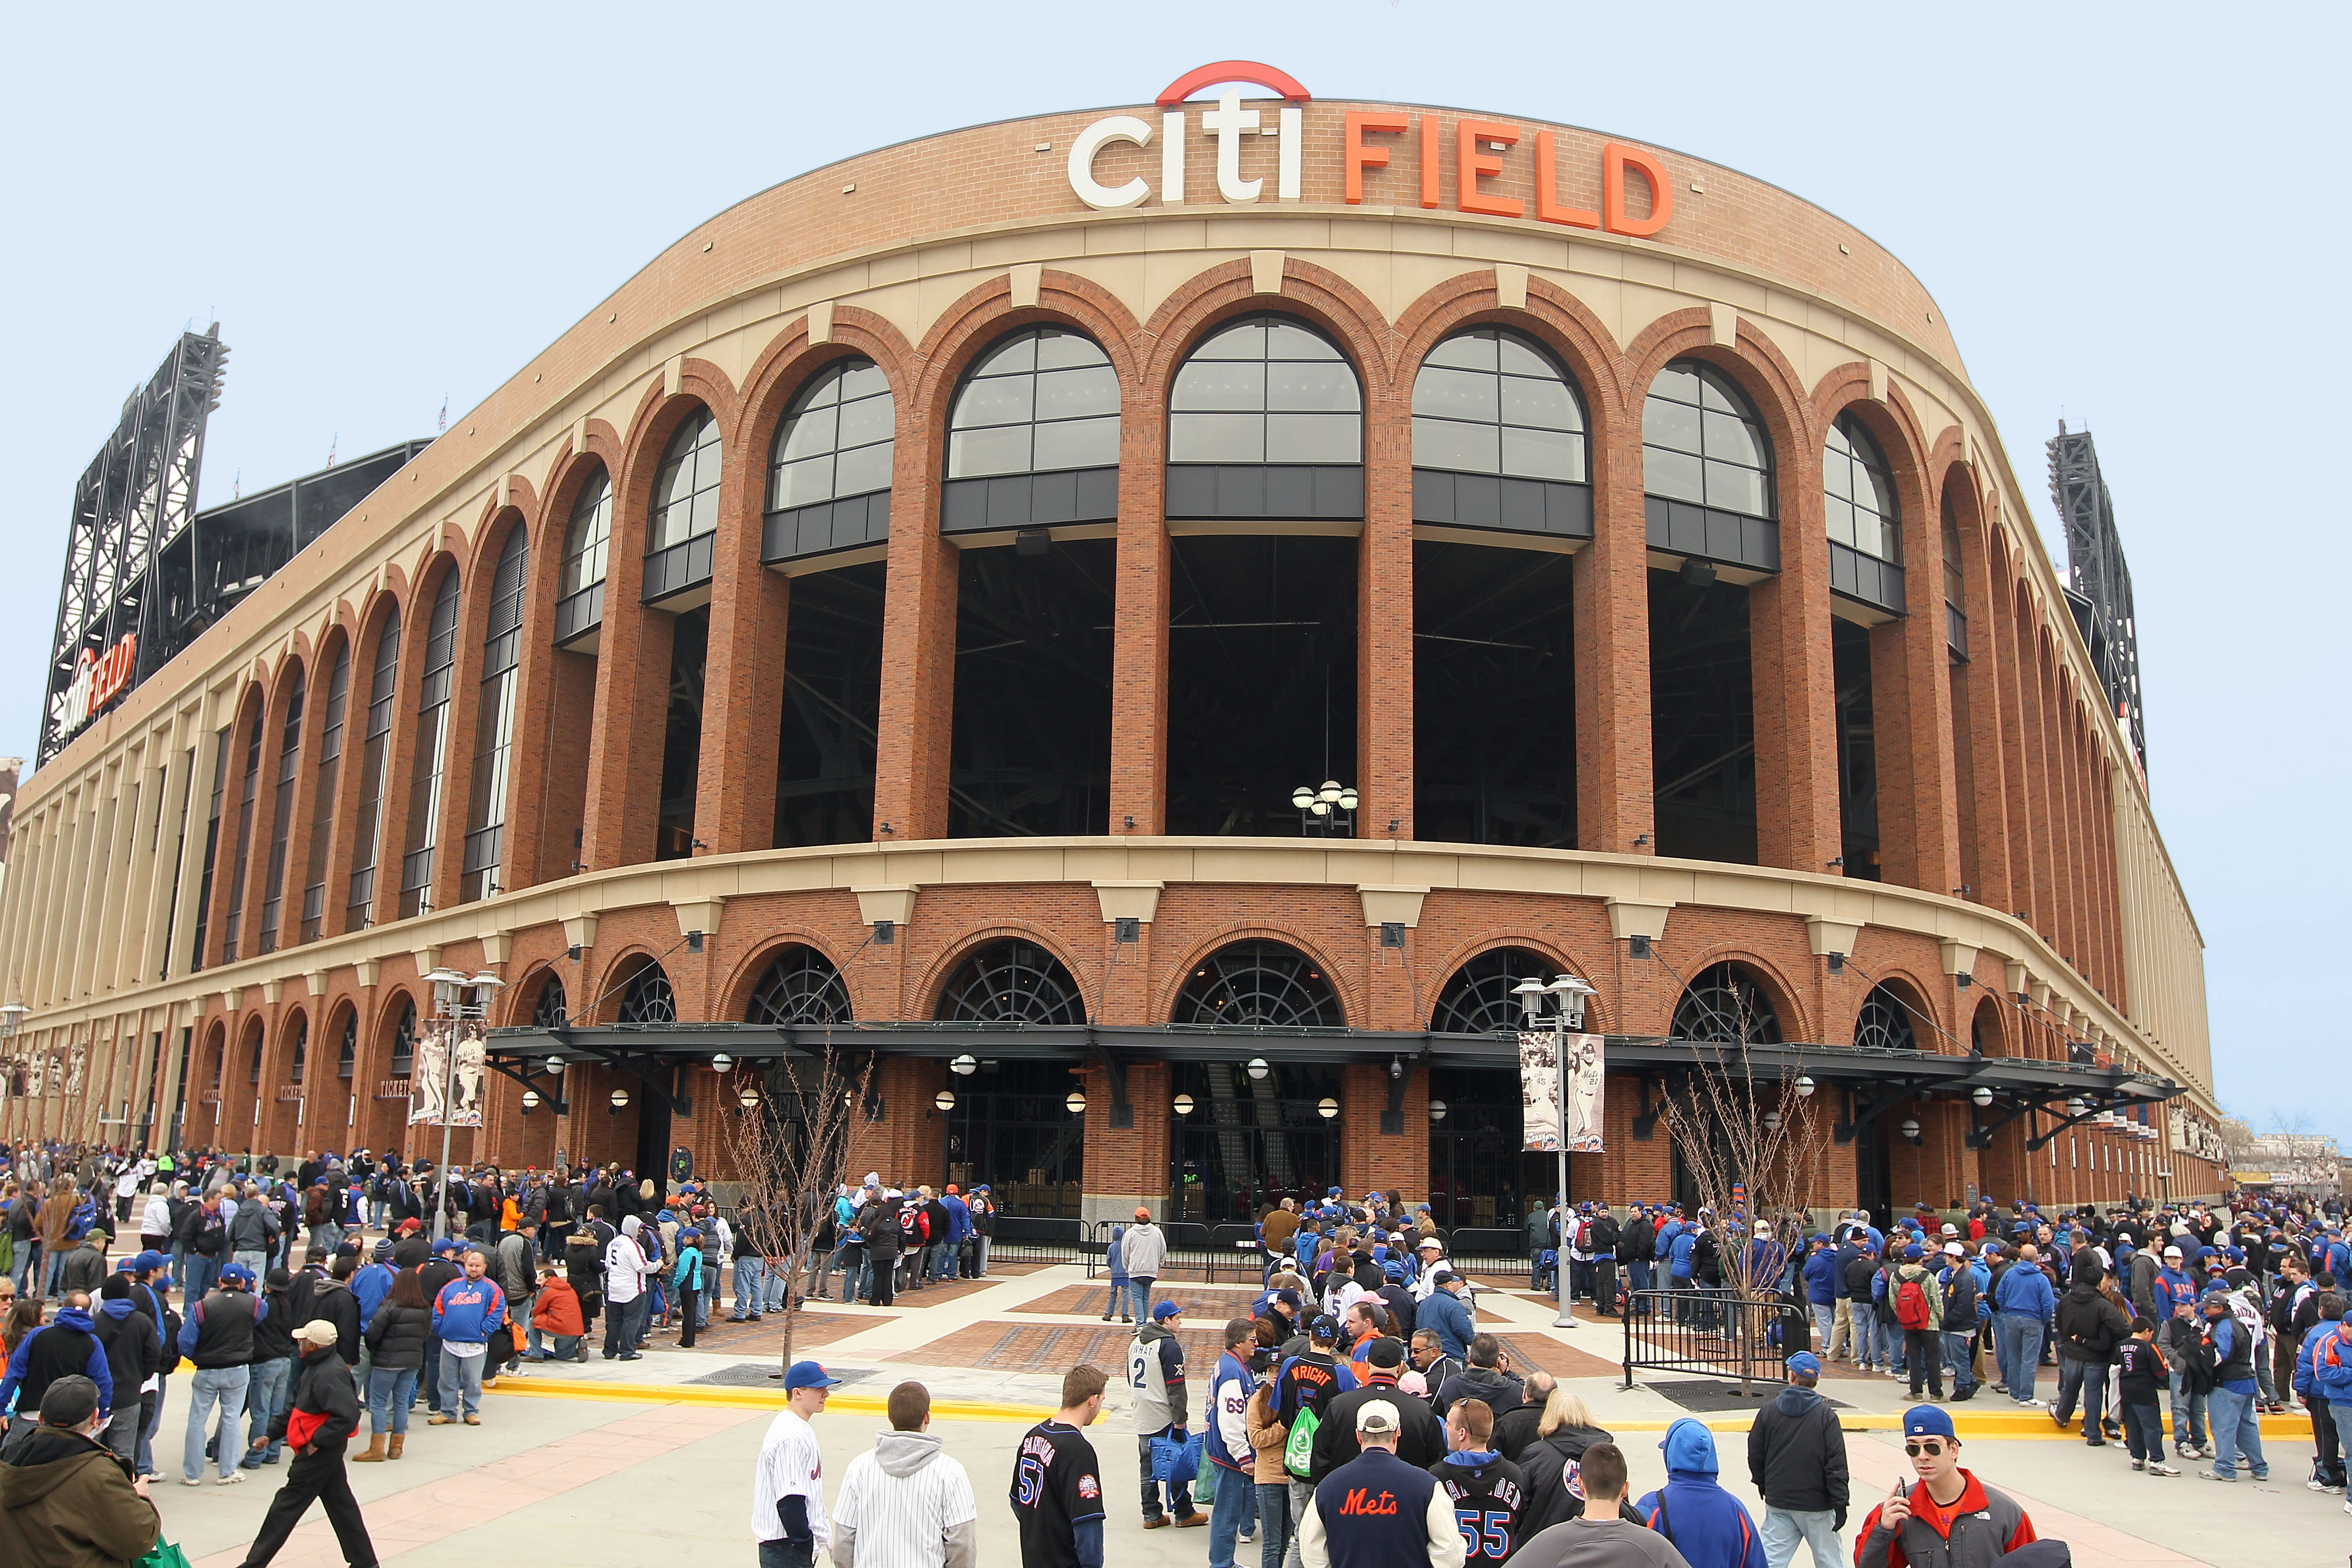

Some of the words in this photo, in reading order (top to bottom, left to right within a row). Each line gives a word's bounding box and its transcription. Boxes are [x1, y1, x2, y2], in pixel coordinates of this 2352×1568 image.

[1344, 111, 1673, 239] FIELD
[86, 633, 136, 717] FIELD
[1581, 1070, 1598, 1079] Mets
[341, 1195, 348, 1209] 5
[611, 1249, 618, 1266] 5
[448, 1291, 482, 1306] Mets
[1332, 1298, 1341, 1319] 5
[2124, 1353, 2133, 1371] 5
[1133, 1357, 1147, 1389] 2
[1291, 1365, 1332, 1387] WRIGHT
[1224, 1397, 1245, 1415] '69
[1339, 1487, 1397, 1516] Mets
[1455, 1509, 1512, 1560] 55
